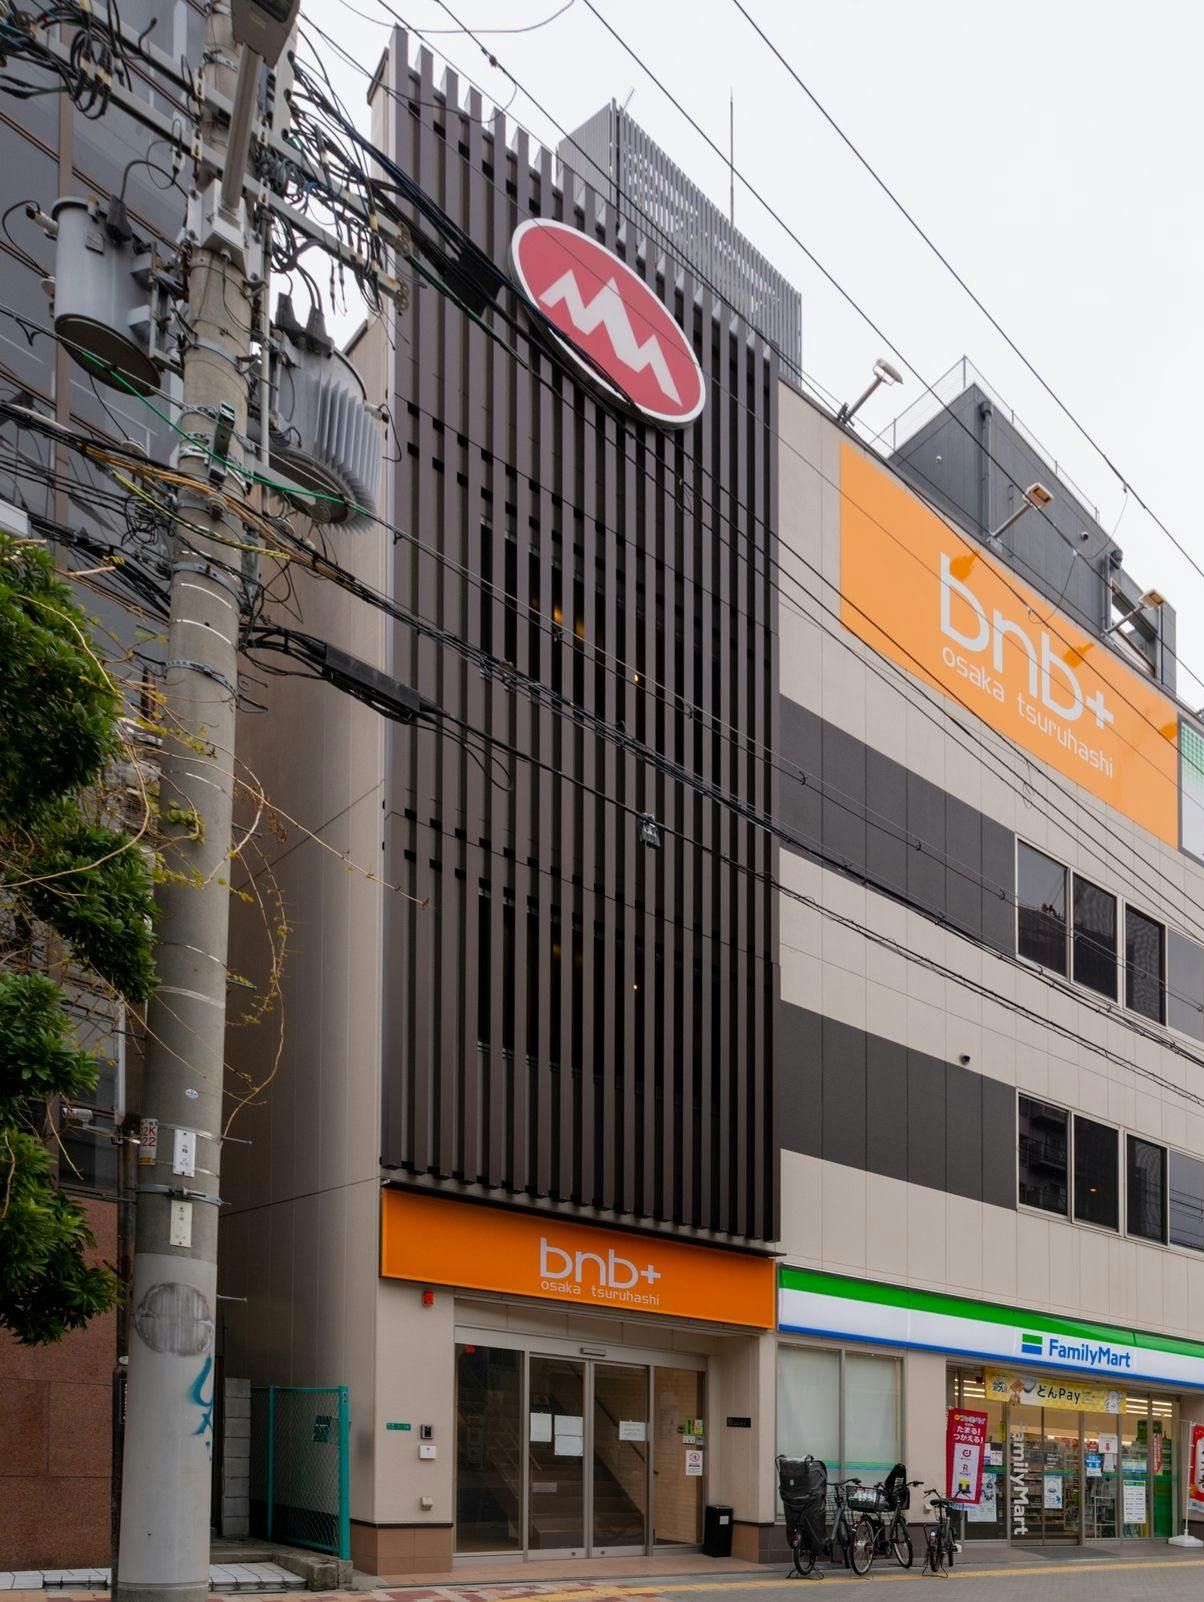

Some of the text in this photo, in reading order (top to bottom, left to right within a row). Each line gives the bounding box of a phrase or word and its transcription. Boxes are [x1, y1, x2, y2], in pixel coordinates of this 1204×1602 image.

[942, 646, 1113, 779] osaka tsuruhashi
[541, 1280, 660, 1306] osaka tsuruhashi
[1049, 1338, 1131, 1368] FamilyMart
[1037, 1384, 1081, 1405] どんPay
